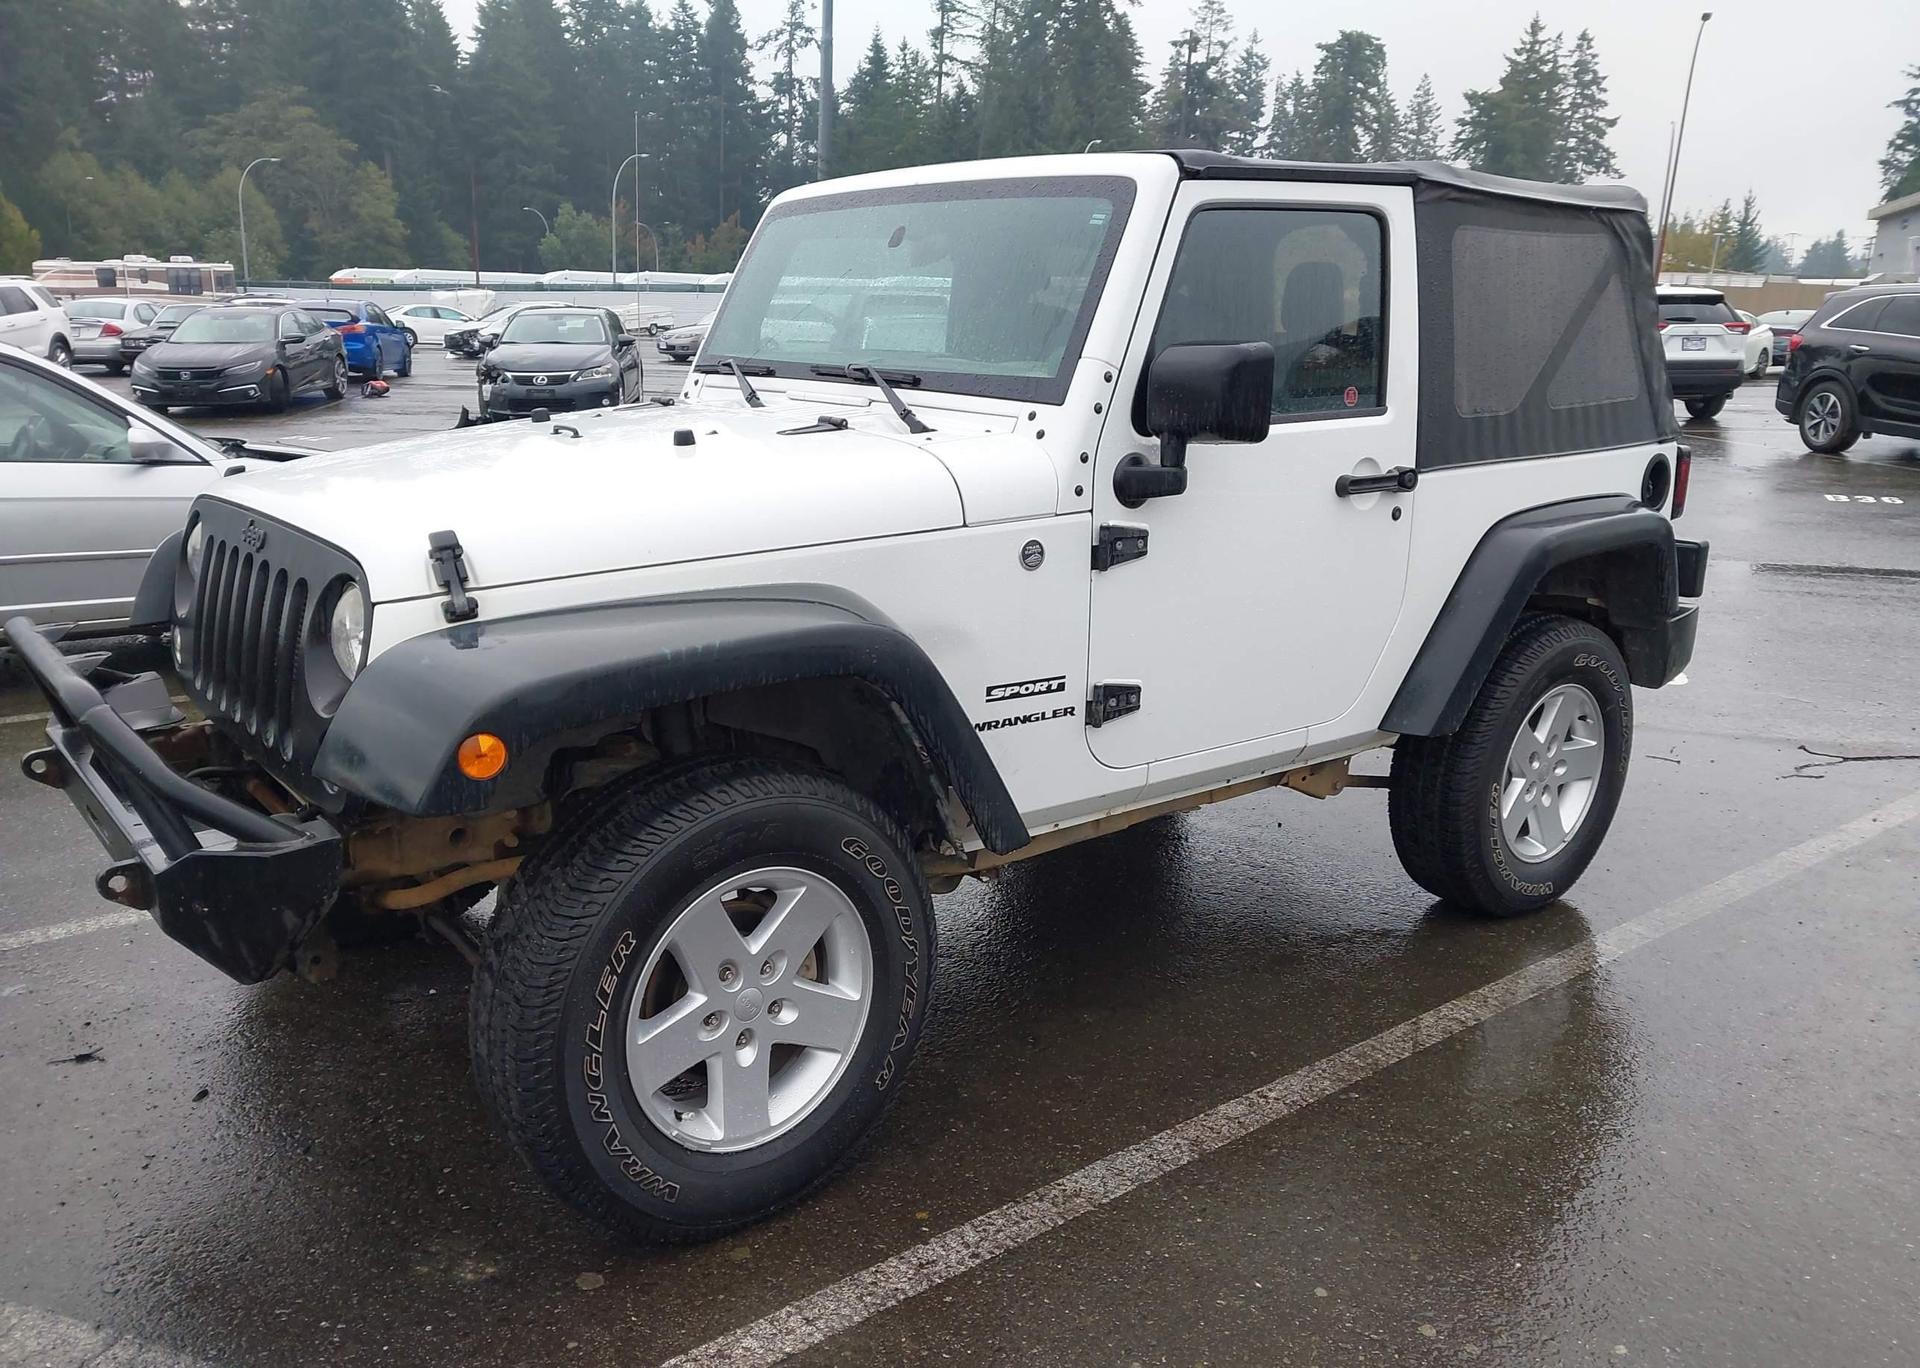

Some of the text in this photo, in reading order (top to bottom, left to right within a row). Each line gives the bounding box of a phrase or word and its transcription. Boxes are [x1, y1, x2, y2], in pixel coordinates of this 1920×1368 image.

[974, 706, 1076, 732] WRANGLER
[986, 678, 1066, 700] SPORT
[1574, 653, 1630, 773] GOODYEAR
[1488, 783, 1554, 896] WRANGLER
[841, 837, 920, 1091] GOODYEAR
[584, 931, 681, 1203] WRANGLER
